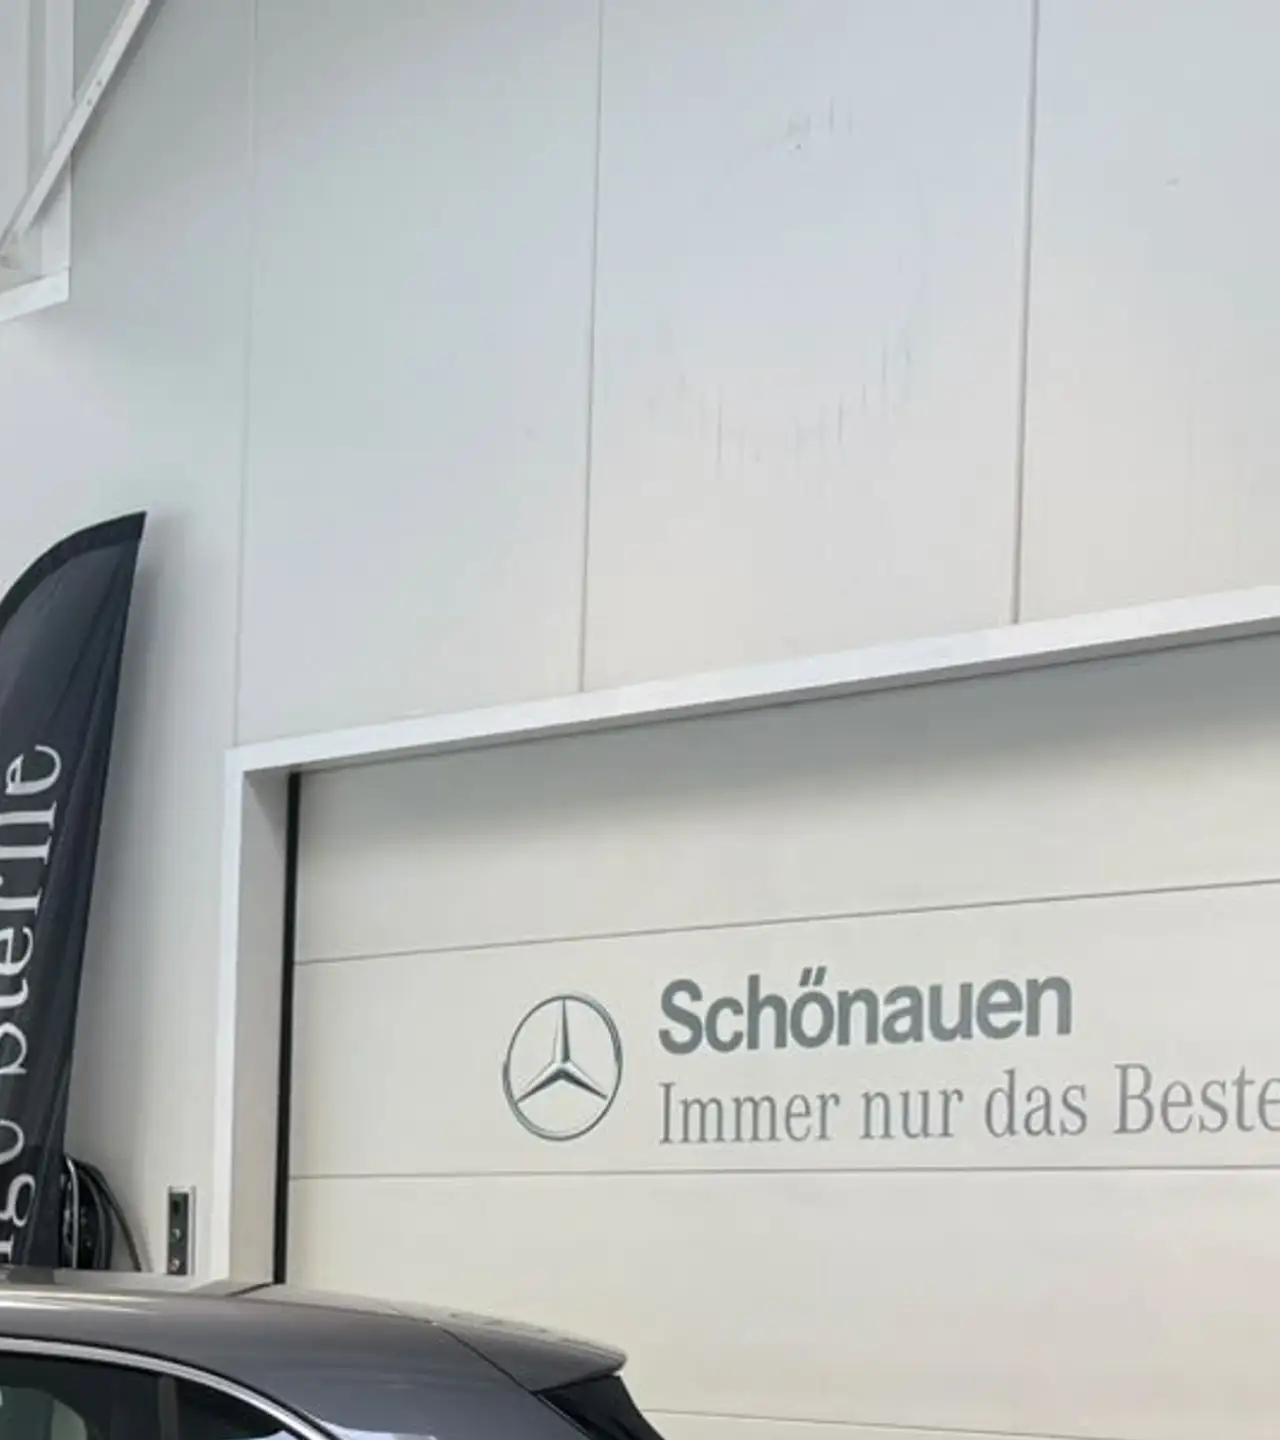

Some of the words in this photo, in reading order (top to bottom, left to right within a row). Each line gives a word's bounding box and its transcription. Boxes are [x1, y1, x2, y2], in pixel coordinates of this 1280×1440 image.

[658, 966, 1073, 1055] Schönauen
[658, 1082, 840, 1145] Immer
[860, 1087, 964, 1140] nur
[984, 1068, 1088, 1139] das
[1112, 1062, 1280, 1135] Beste
